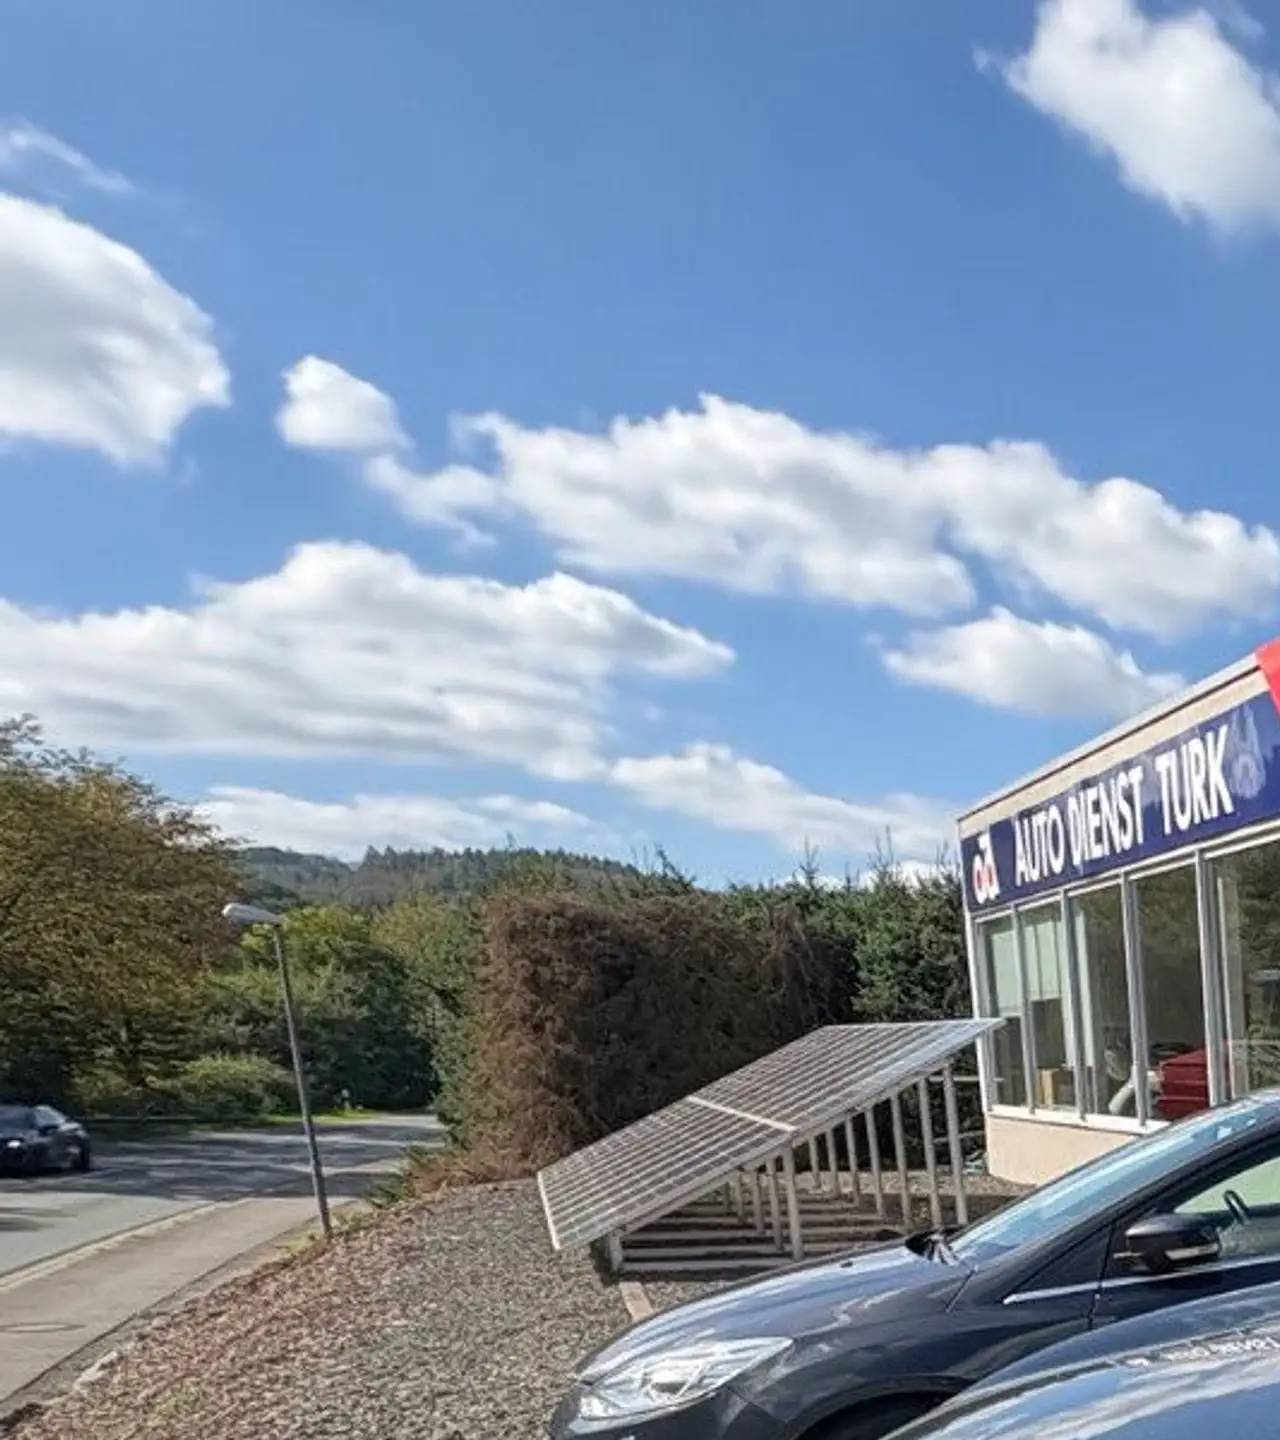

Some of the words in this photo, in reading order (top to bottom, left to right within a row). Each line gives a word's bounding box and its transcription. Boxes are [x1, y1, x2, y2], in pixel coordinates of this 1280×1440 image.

[1012, 812, 1066, 887] AUTO
[1067, 765, 1145, 871] DIENST
[1156, 725, 1234, 837] TURK
